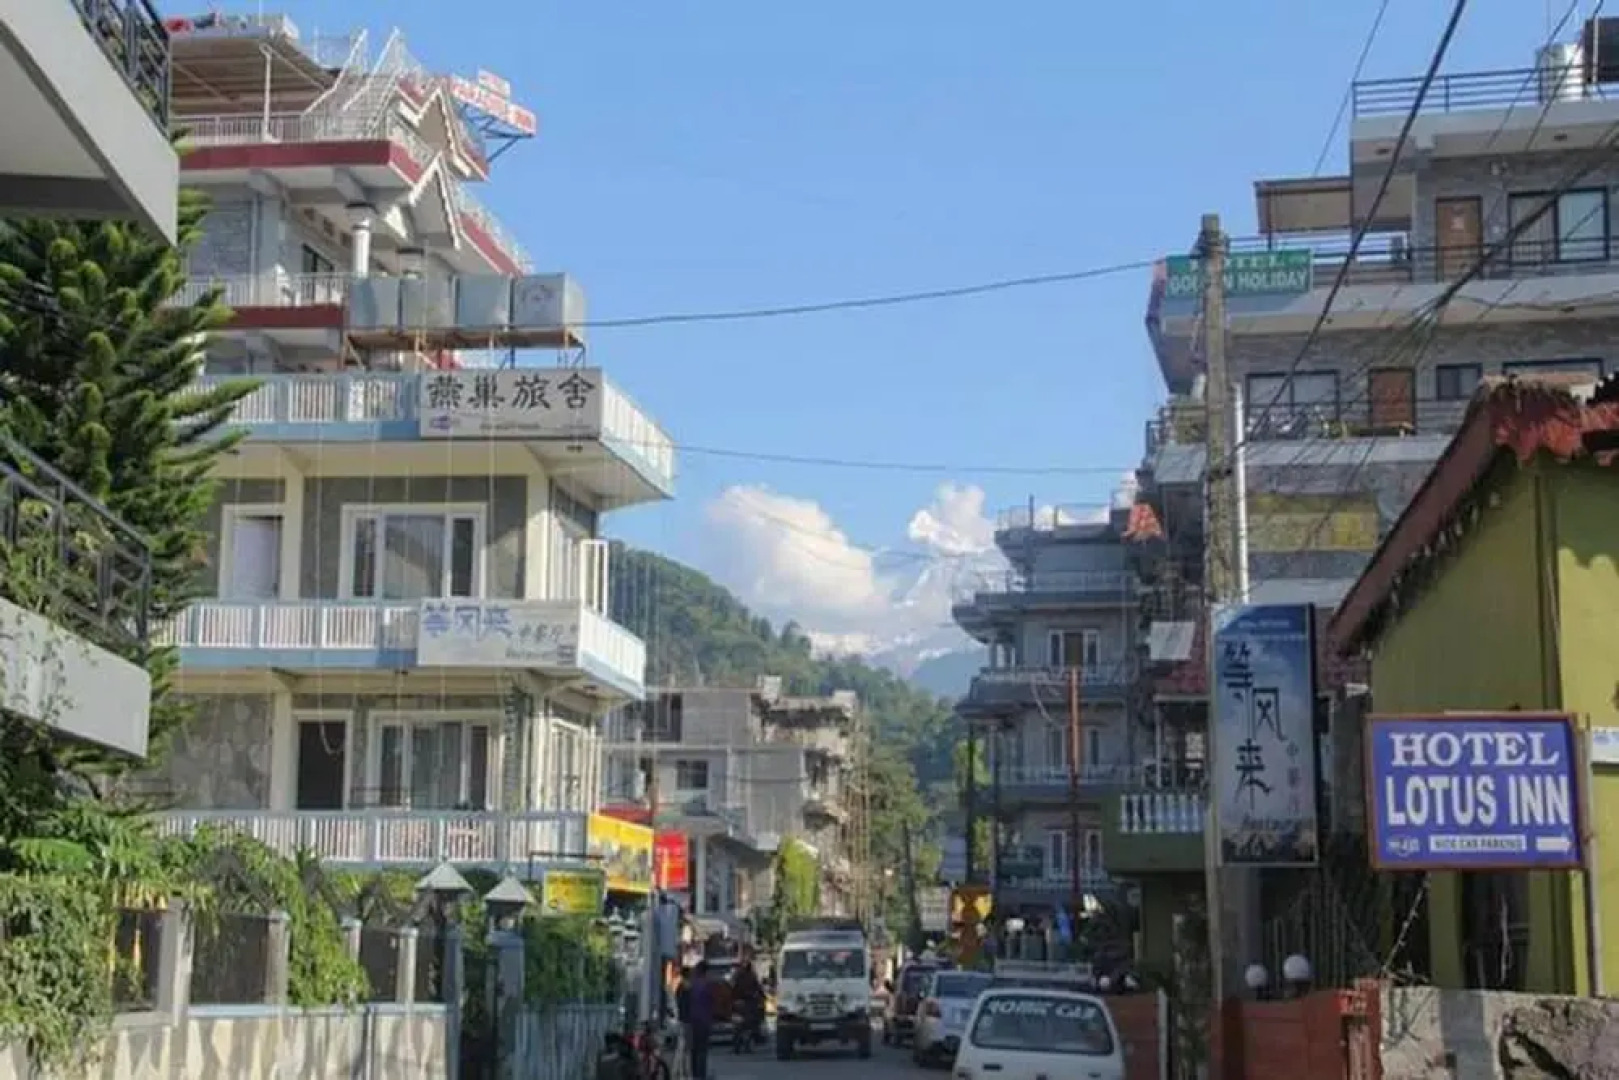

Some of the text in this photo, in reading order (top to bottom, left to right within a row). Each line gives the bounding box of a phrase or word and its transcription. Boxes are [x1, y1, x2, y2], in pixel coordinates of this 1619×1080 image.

[1238, 269, 1307, 290] HOLIDAY
[1389, 731, 1560, 767] HOTEL
[1386, 774, 1570, 826] LOTUS INN
